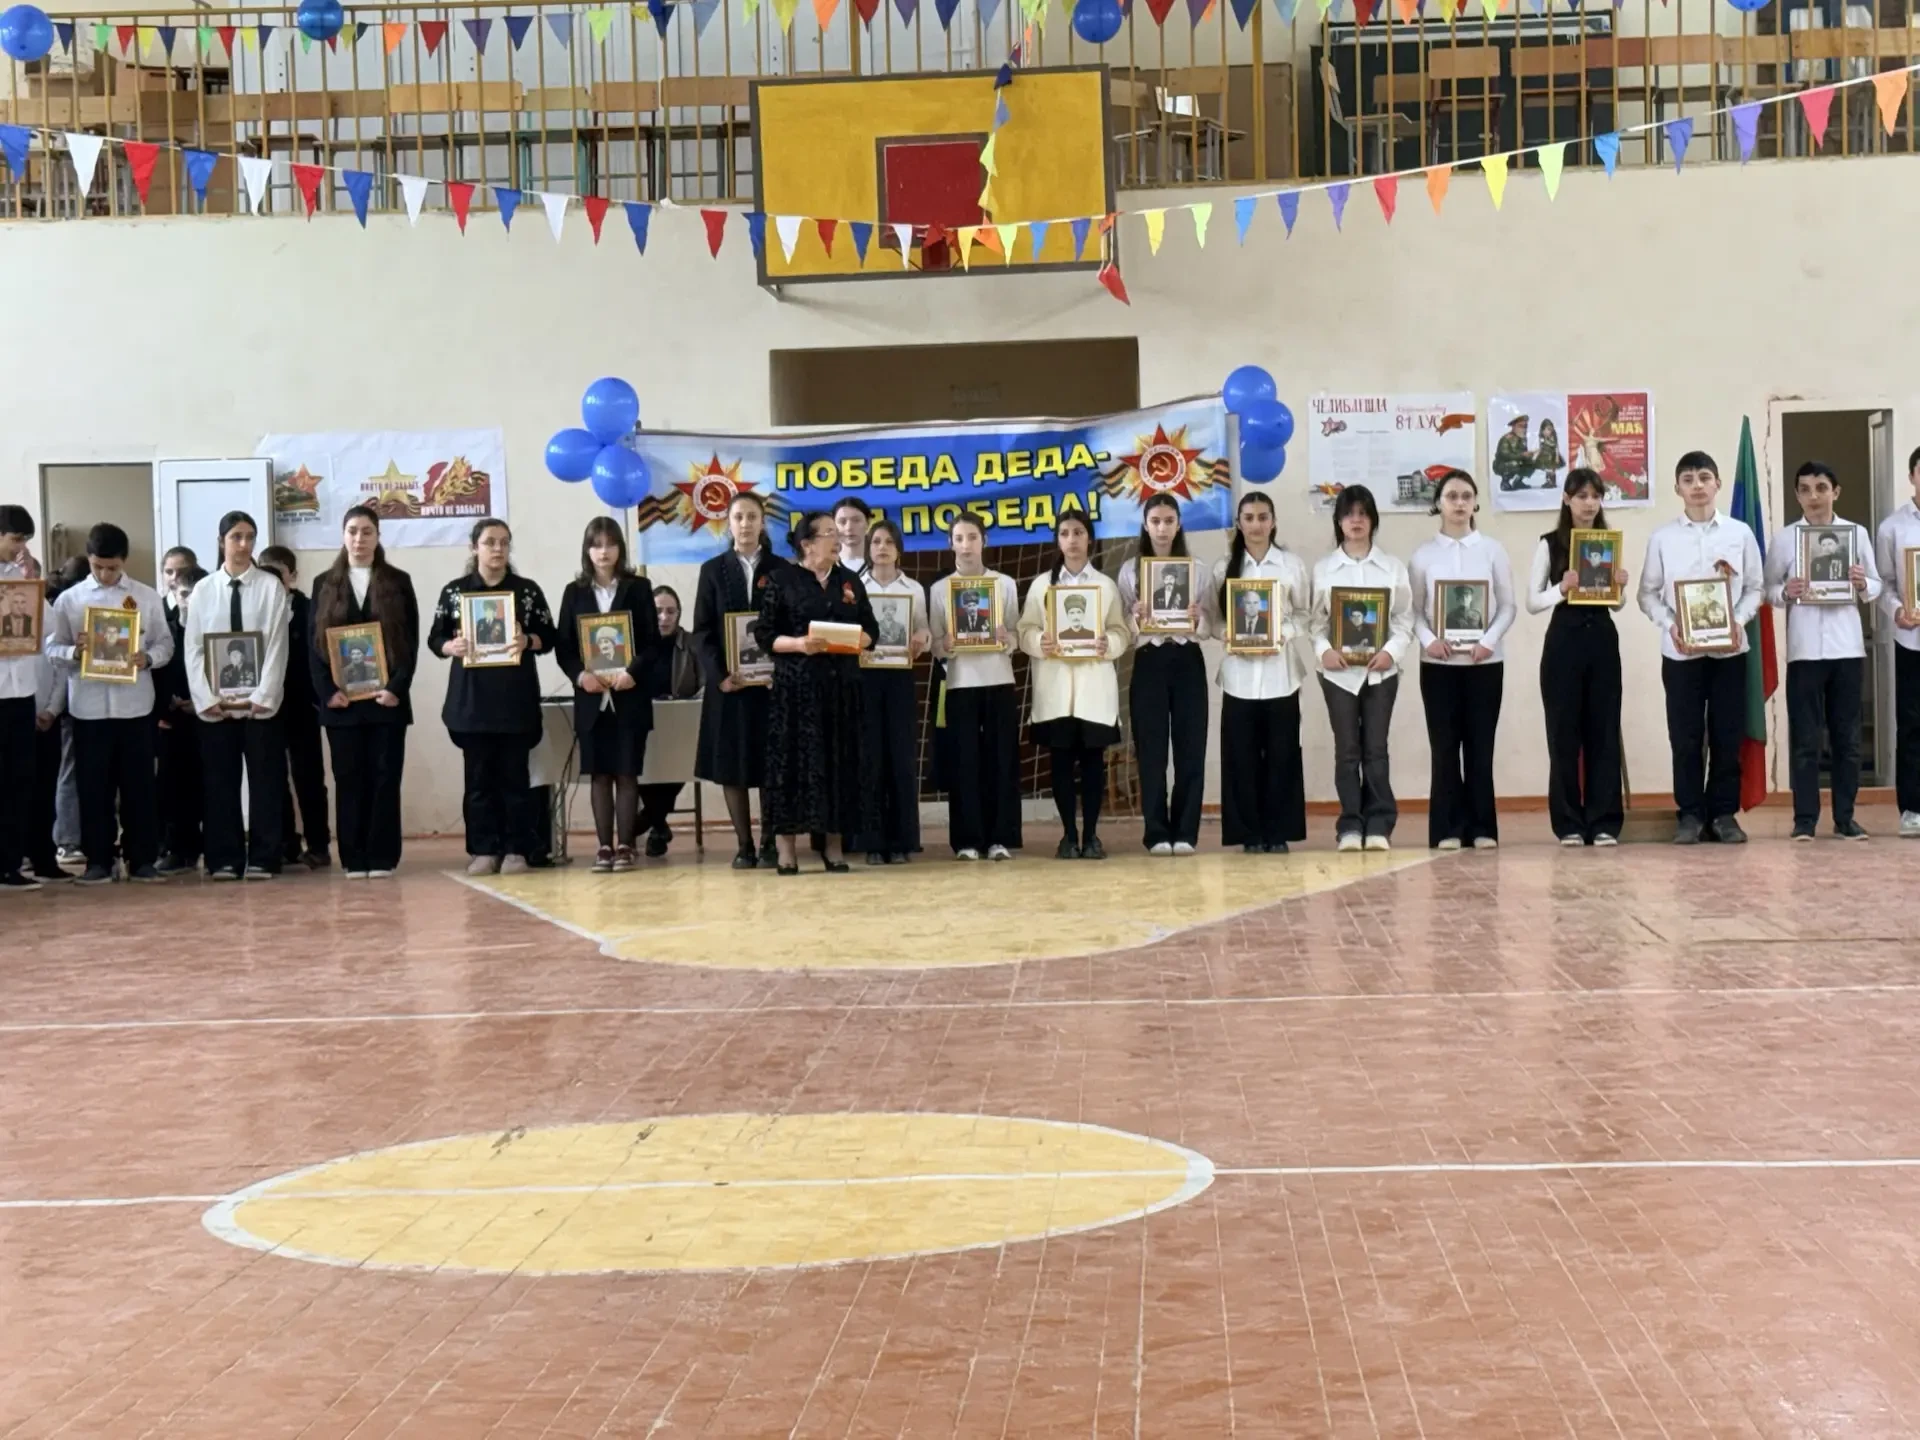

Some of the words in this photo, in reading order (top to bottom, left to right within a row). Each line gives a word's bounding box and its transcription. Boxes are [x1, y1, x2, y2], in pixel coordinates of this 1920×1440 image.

[1396, 414, 1411, 431] 81
[1611, 422, 1643, 434] МАЯ
[776, 454, 963, 490] ПОБЕДА
[972, 443, 1111, 486] ДЕДА-
[455, 504, 485, 515] ЗАБЫТО
[902, 490, 1101, 534] ПОБЕДА!
